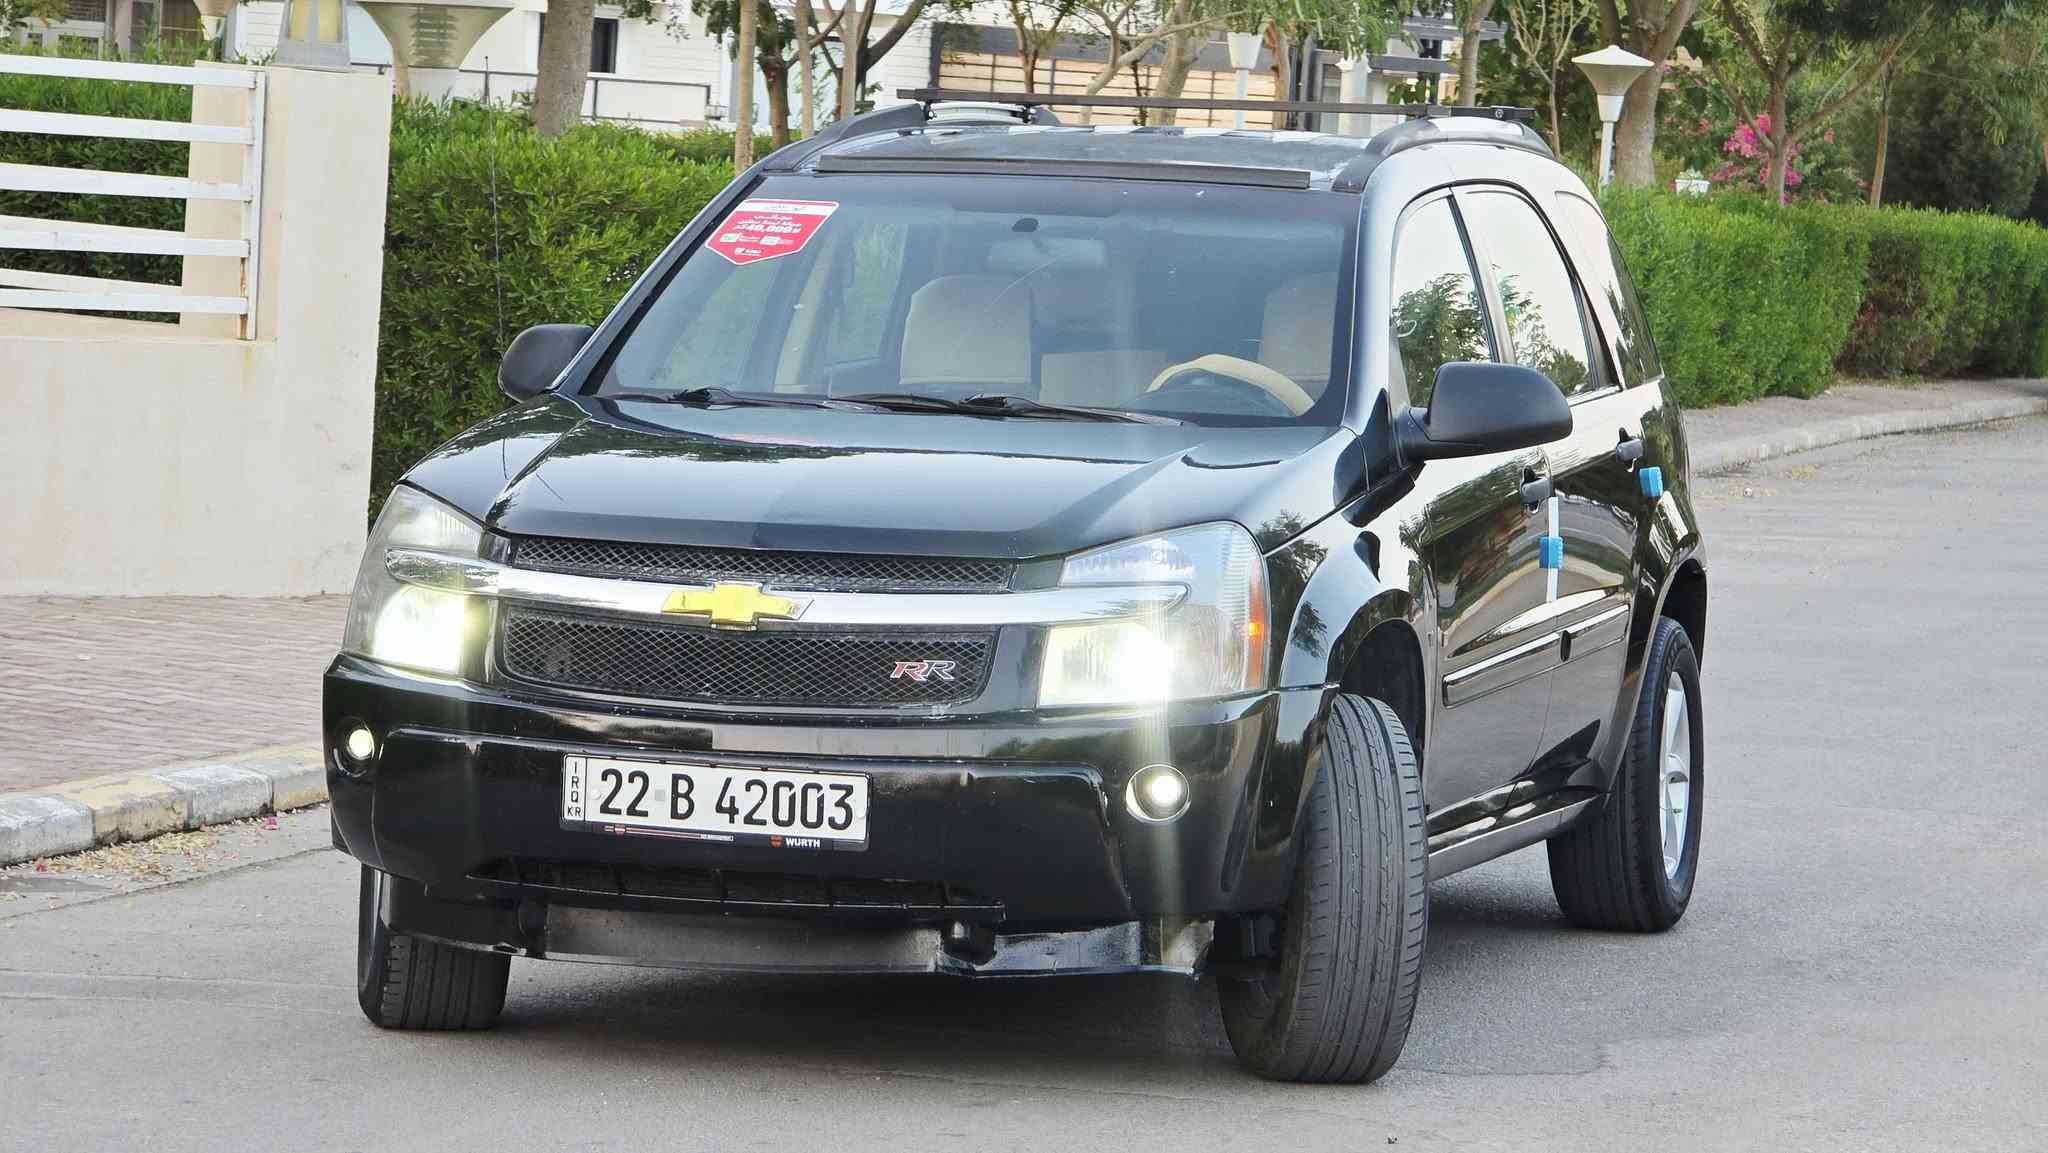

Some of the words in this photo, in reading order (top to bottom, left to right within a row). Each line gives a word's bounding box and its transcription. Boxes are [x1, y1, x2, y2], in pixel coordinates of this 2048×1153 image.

[890, 660, 956, 681] RR
[600, 768, 649, 817] 22
[670, 773, 695, 820] B
[715, 777, 854, 830] 42003
[567, 806, 581, 816] KR
